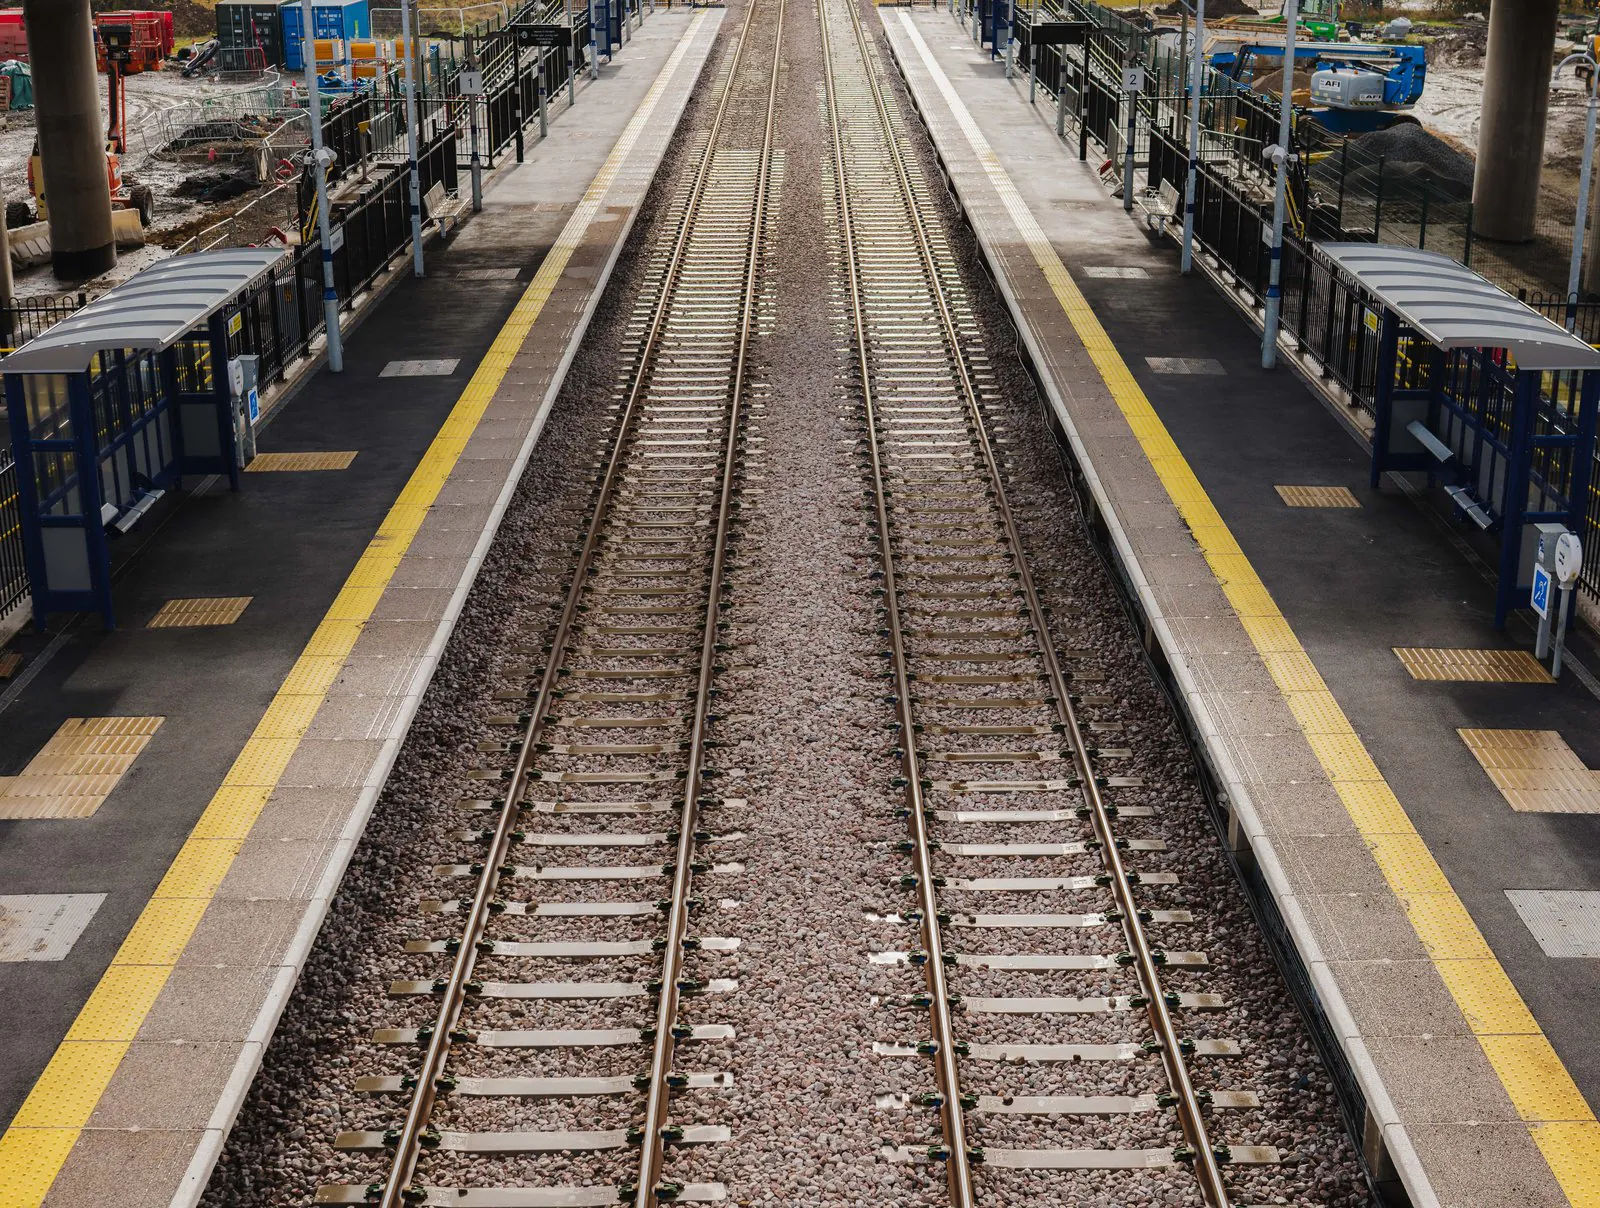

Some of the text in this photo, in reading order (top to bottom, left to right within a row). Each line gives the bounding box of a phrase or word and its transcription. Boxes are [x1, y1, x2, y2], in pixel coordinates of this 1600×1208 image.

[468, 77, 473, 88] 1
[1129, 74, 1137, 85] 2
[1325, 80, 1341, 88] AFI
